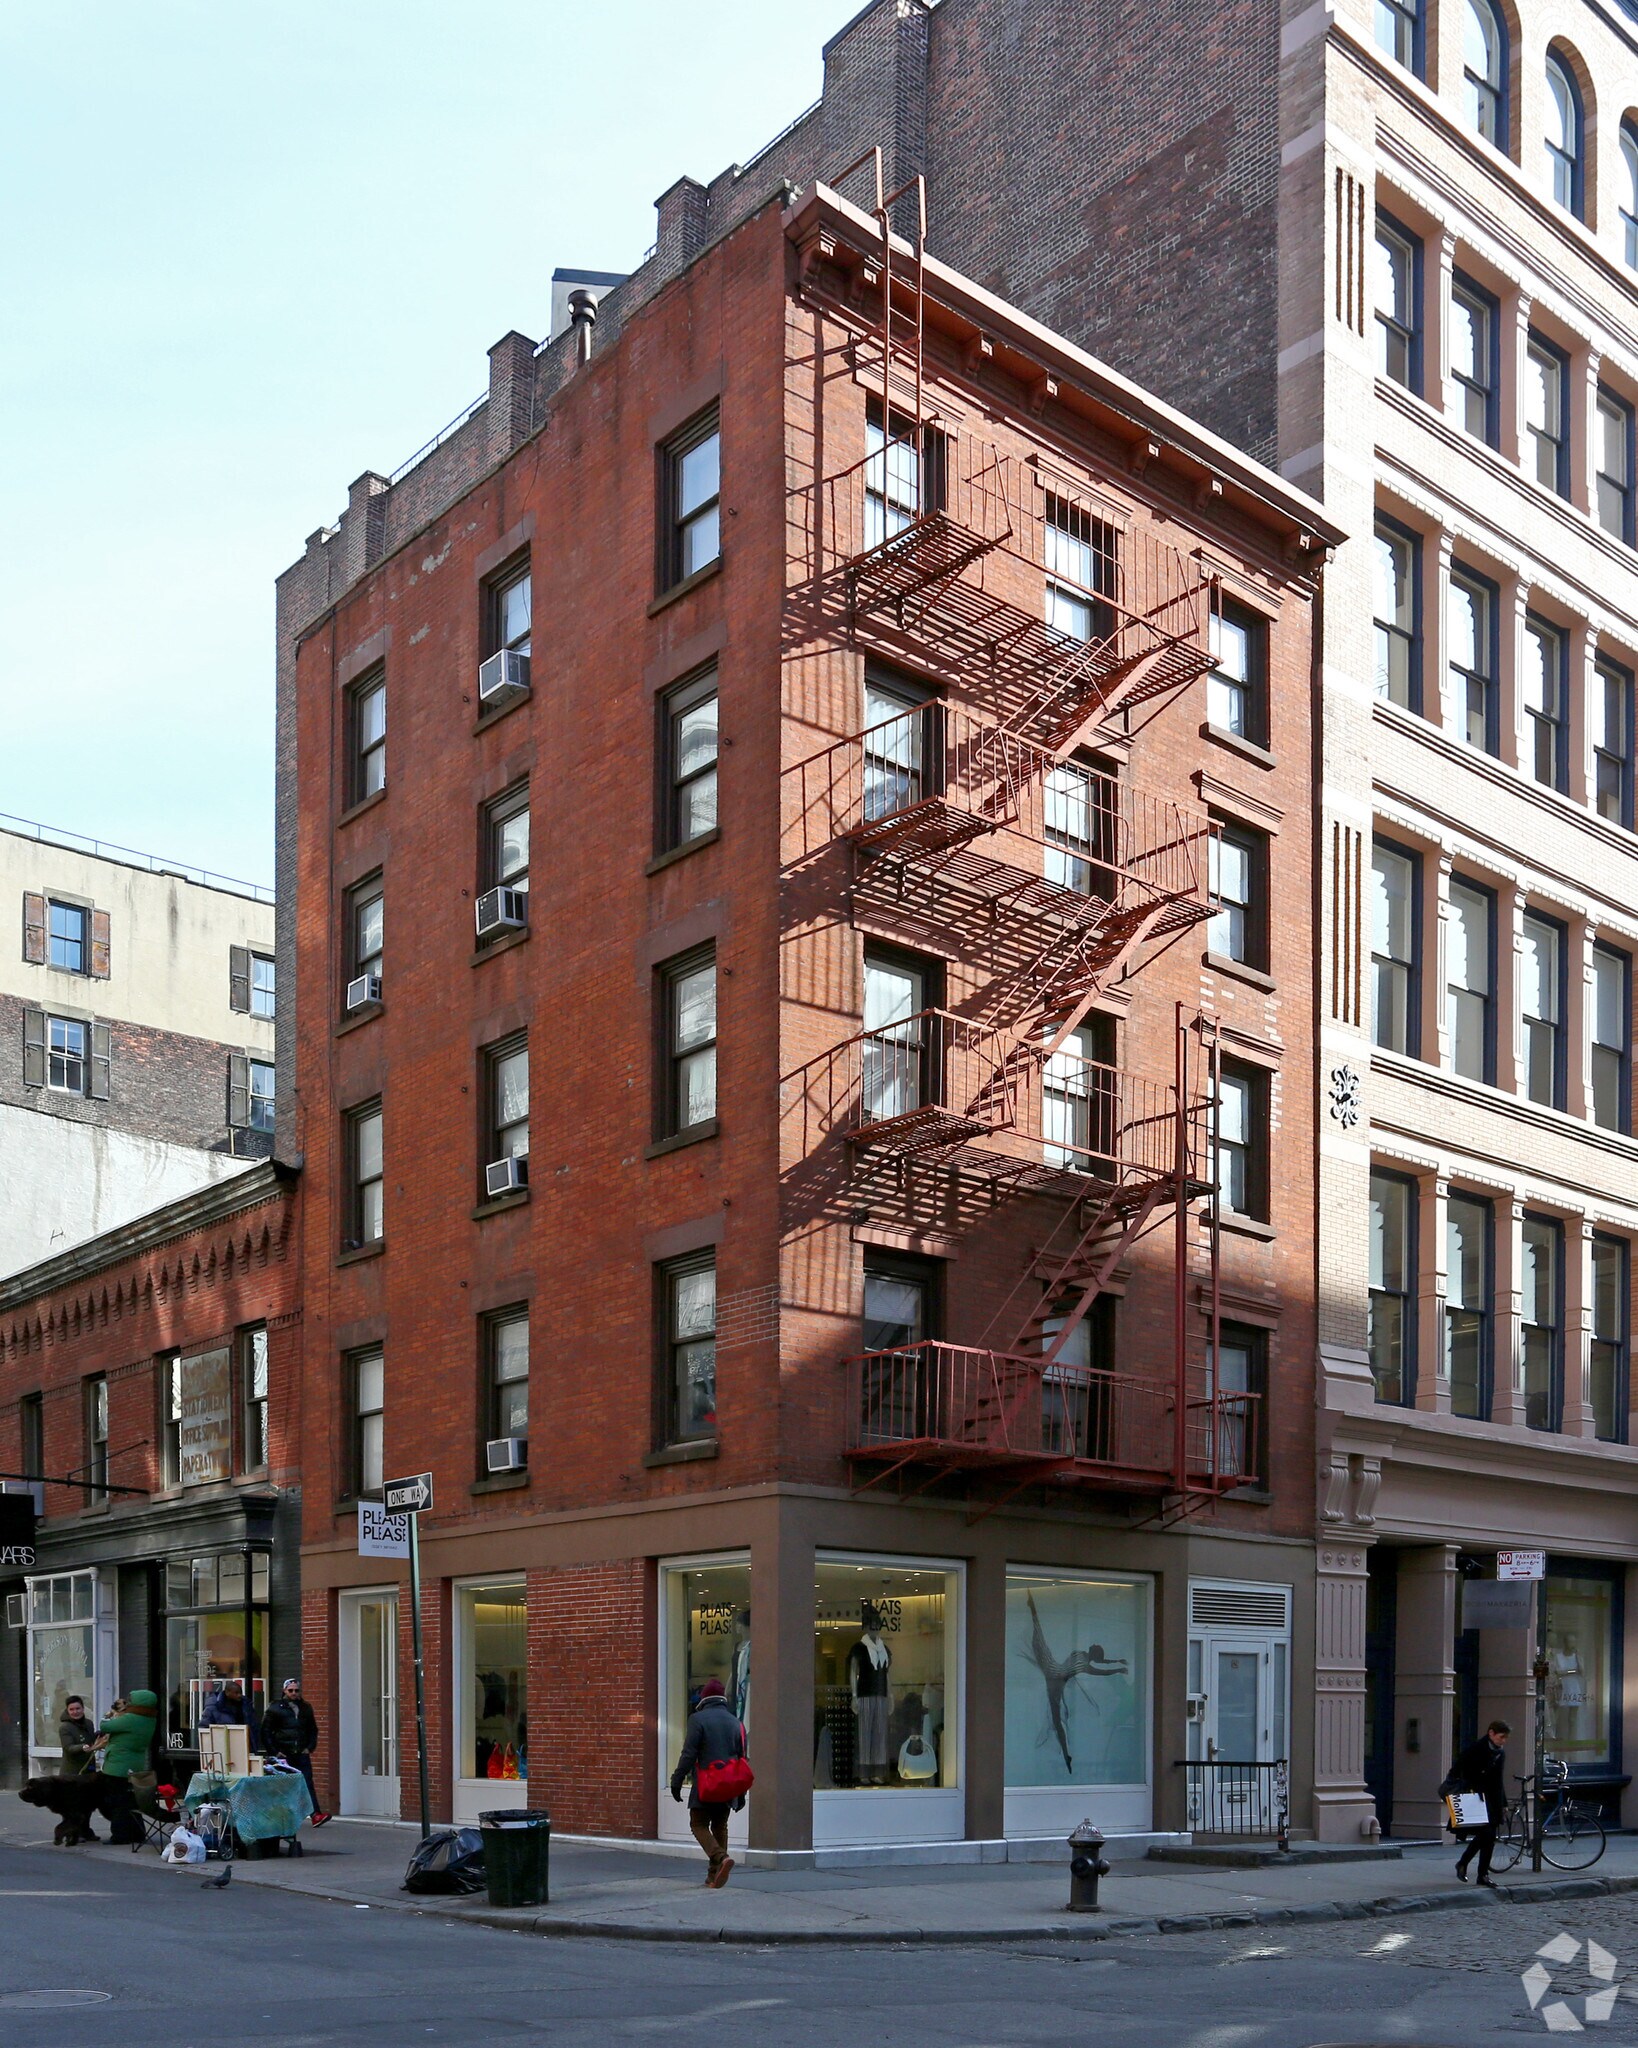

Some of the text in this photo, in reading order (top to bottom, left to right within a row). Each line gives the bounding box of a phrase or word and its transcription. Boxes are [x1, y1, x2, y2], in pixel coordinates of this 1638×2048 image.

[391, 1486, 424, 1505] ONE WAY
[363, 1526, 407, 1542] PLEASE
[1500, 1554, 1512, 1564] NO
[700, 1602, 732, 1618] PLEATS
[700, 1619, 732, 1635] PLEASE
[167, 1732, 184, 1748] NARS
[1453, 1794, 1464, 1823] MoMA
